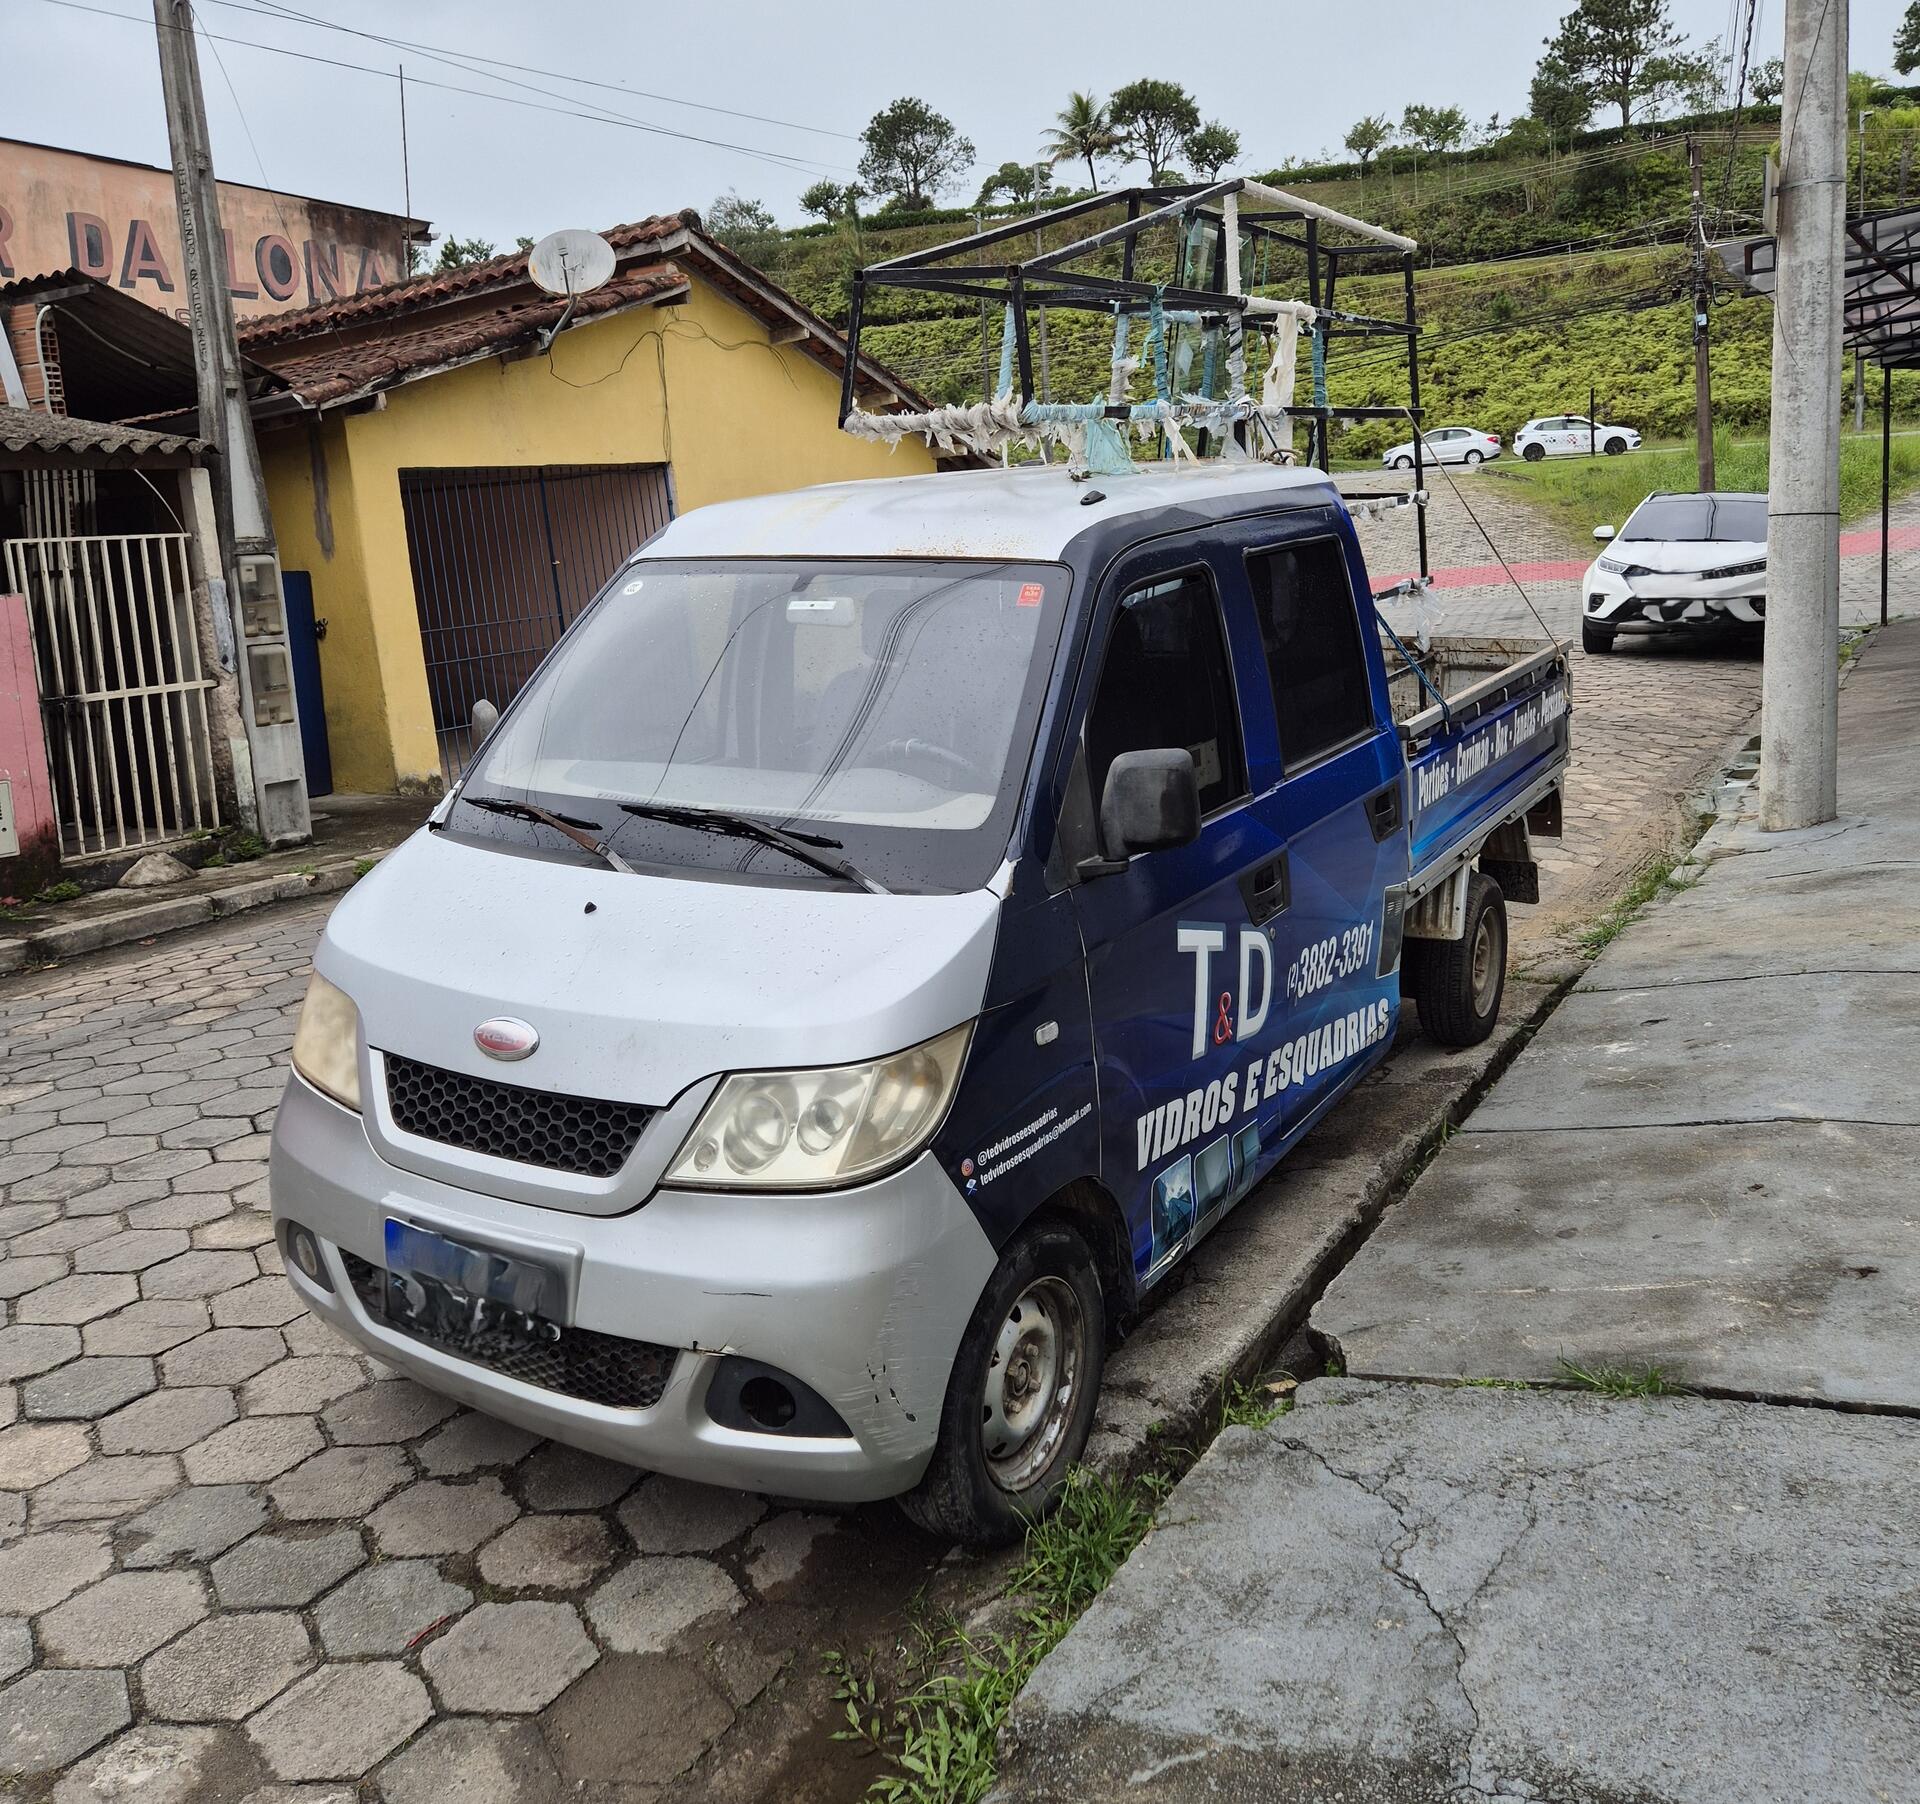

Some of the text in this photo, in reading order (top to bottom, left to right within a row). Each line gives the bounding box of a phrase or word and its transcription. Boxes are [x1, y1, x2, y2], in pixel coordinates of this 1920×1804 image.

[66, 211, 175, 292] DA
[223, 228, 387, 306] LONA
[1418, 752, 1450, 811] Portões
[1456, 727, 1490, 785] Corrimão
[1513, 701, 1537, 748] Janelas
[1136, 998, 1390, 1173] VIDROS E ESQUADRIAS
[977, 1107, 1058, 1167] @tedvidroseesquadrias
[980, 1102, 1092, 1186] tedvidroseesquadrias@hotmail.com
